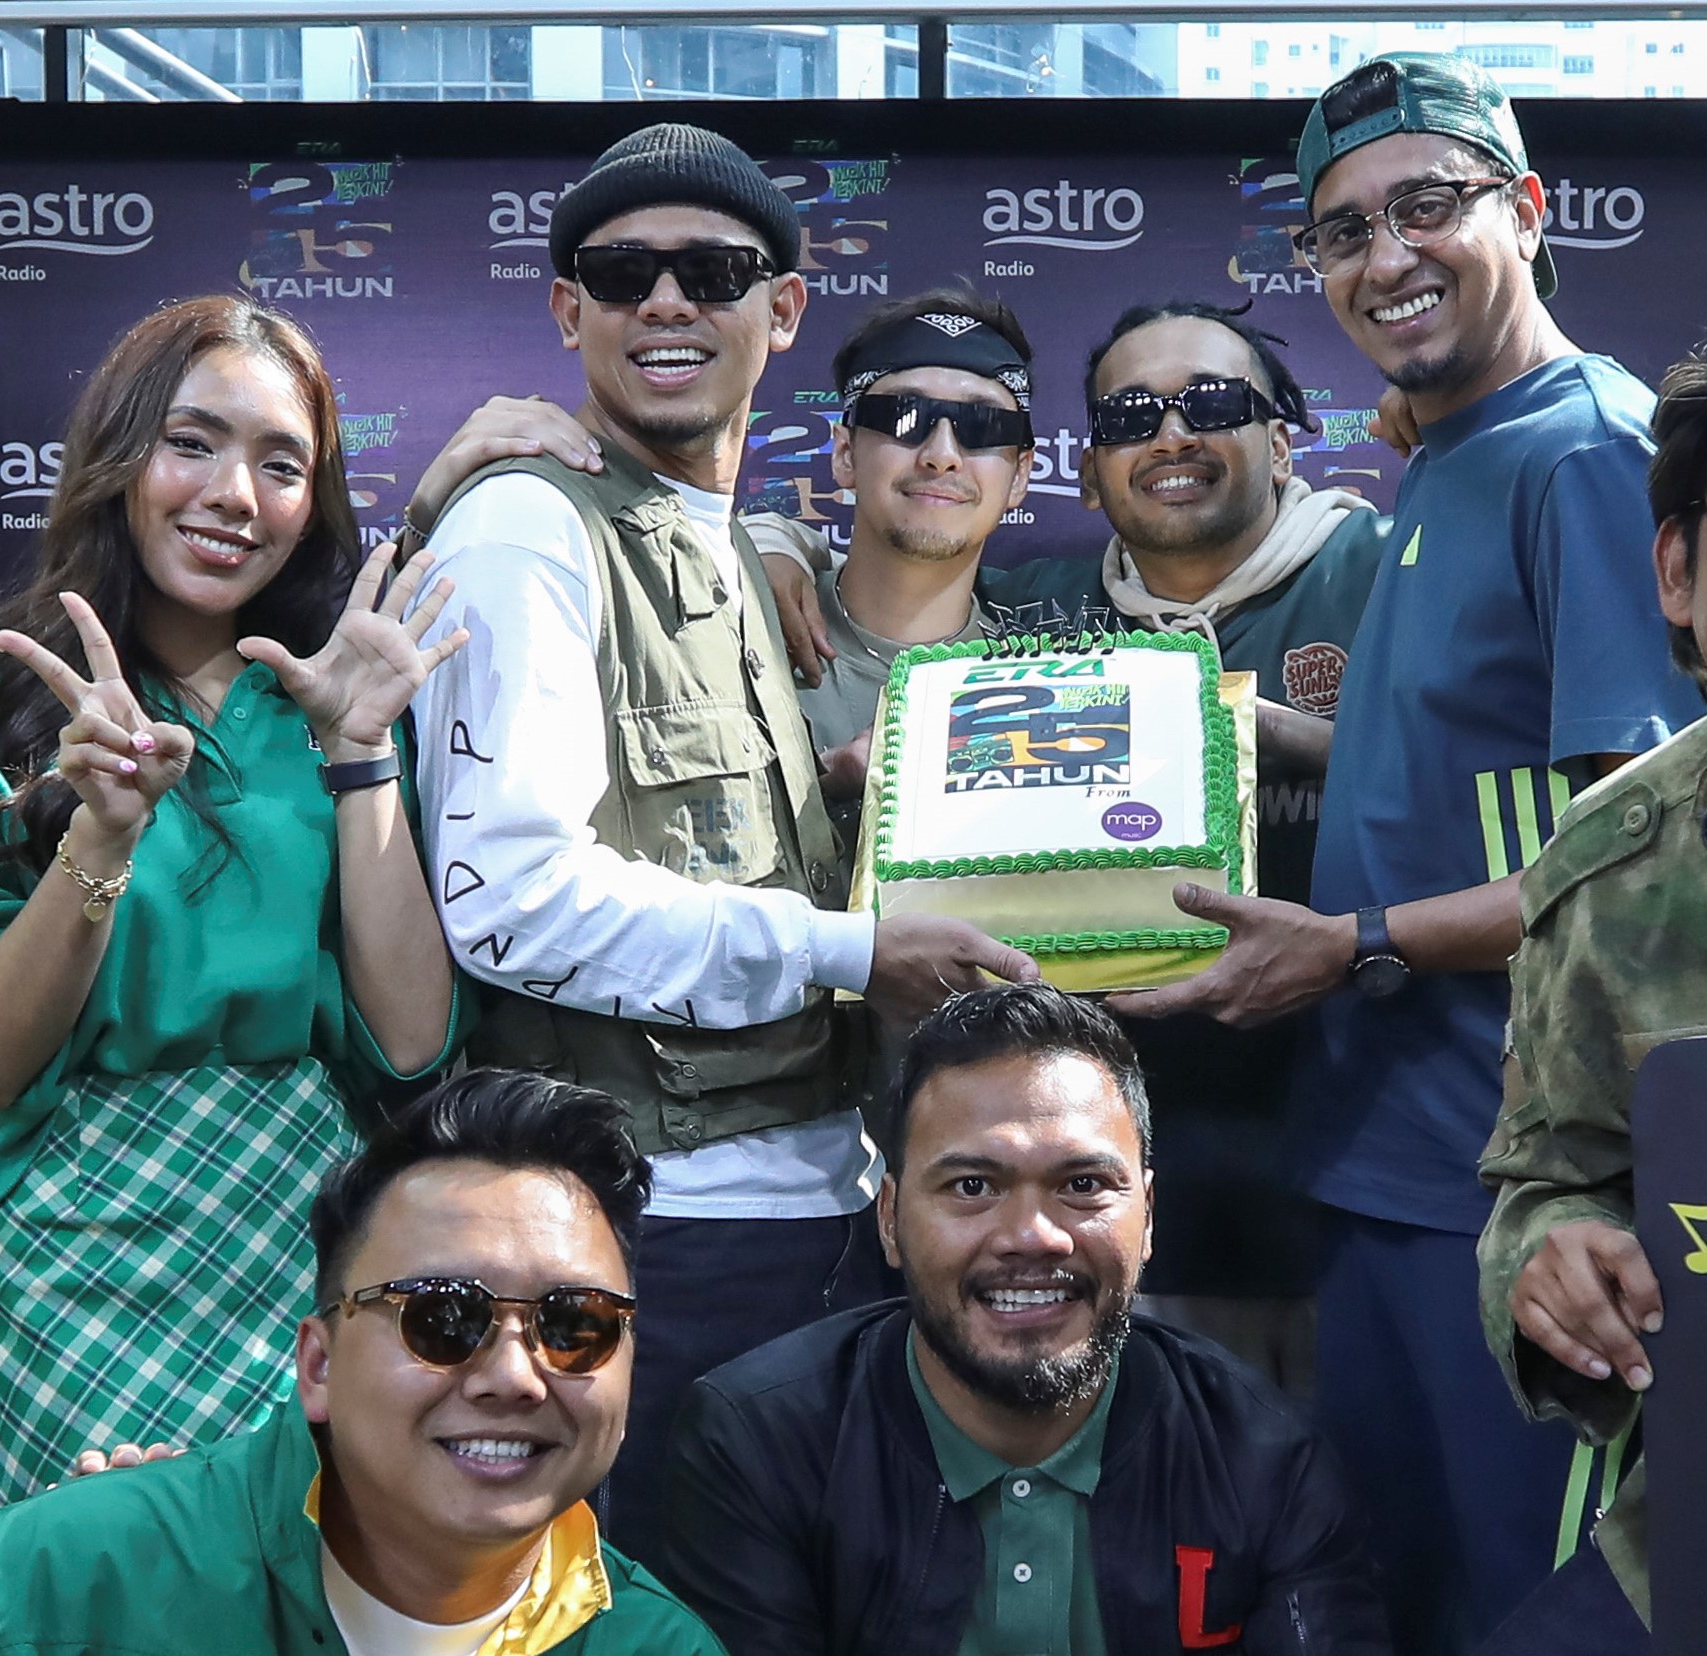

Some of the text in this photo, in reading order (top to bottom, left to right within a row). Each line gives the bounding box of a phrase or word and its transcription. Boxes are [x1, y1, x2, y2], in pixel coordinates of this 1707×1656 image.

[982, 179, 1144, 234] astro
[490, 262, 541, 279] Radio
[984, 260, 1034, 277] Radio
[253, 276, 393, 299] TAHUN
[803, 274, 888, 295] HUN
[1241, 272, 1323, 295] TAH
[793, 390, 840, 404] ERA
[962, 658, 1106, 685] ERA
[950, 685, 1130, 765] 25
[950, 764, 1130, 791] TAHUN
[1085, 785, 1131, 798] From
[1106, 813, 1157, 831] map
[1175, 1544, 1242, 1650] L
